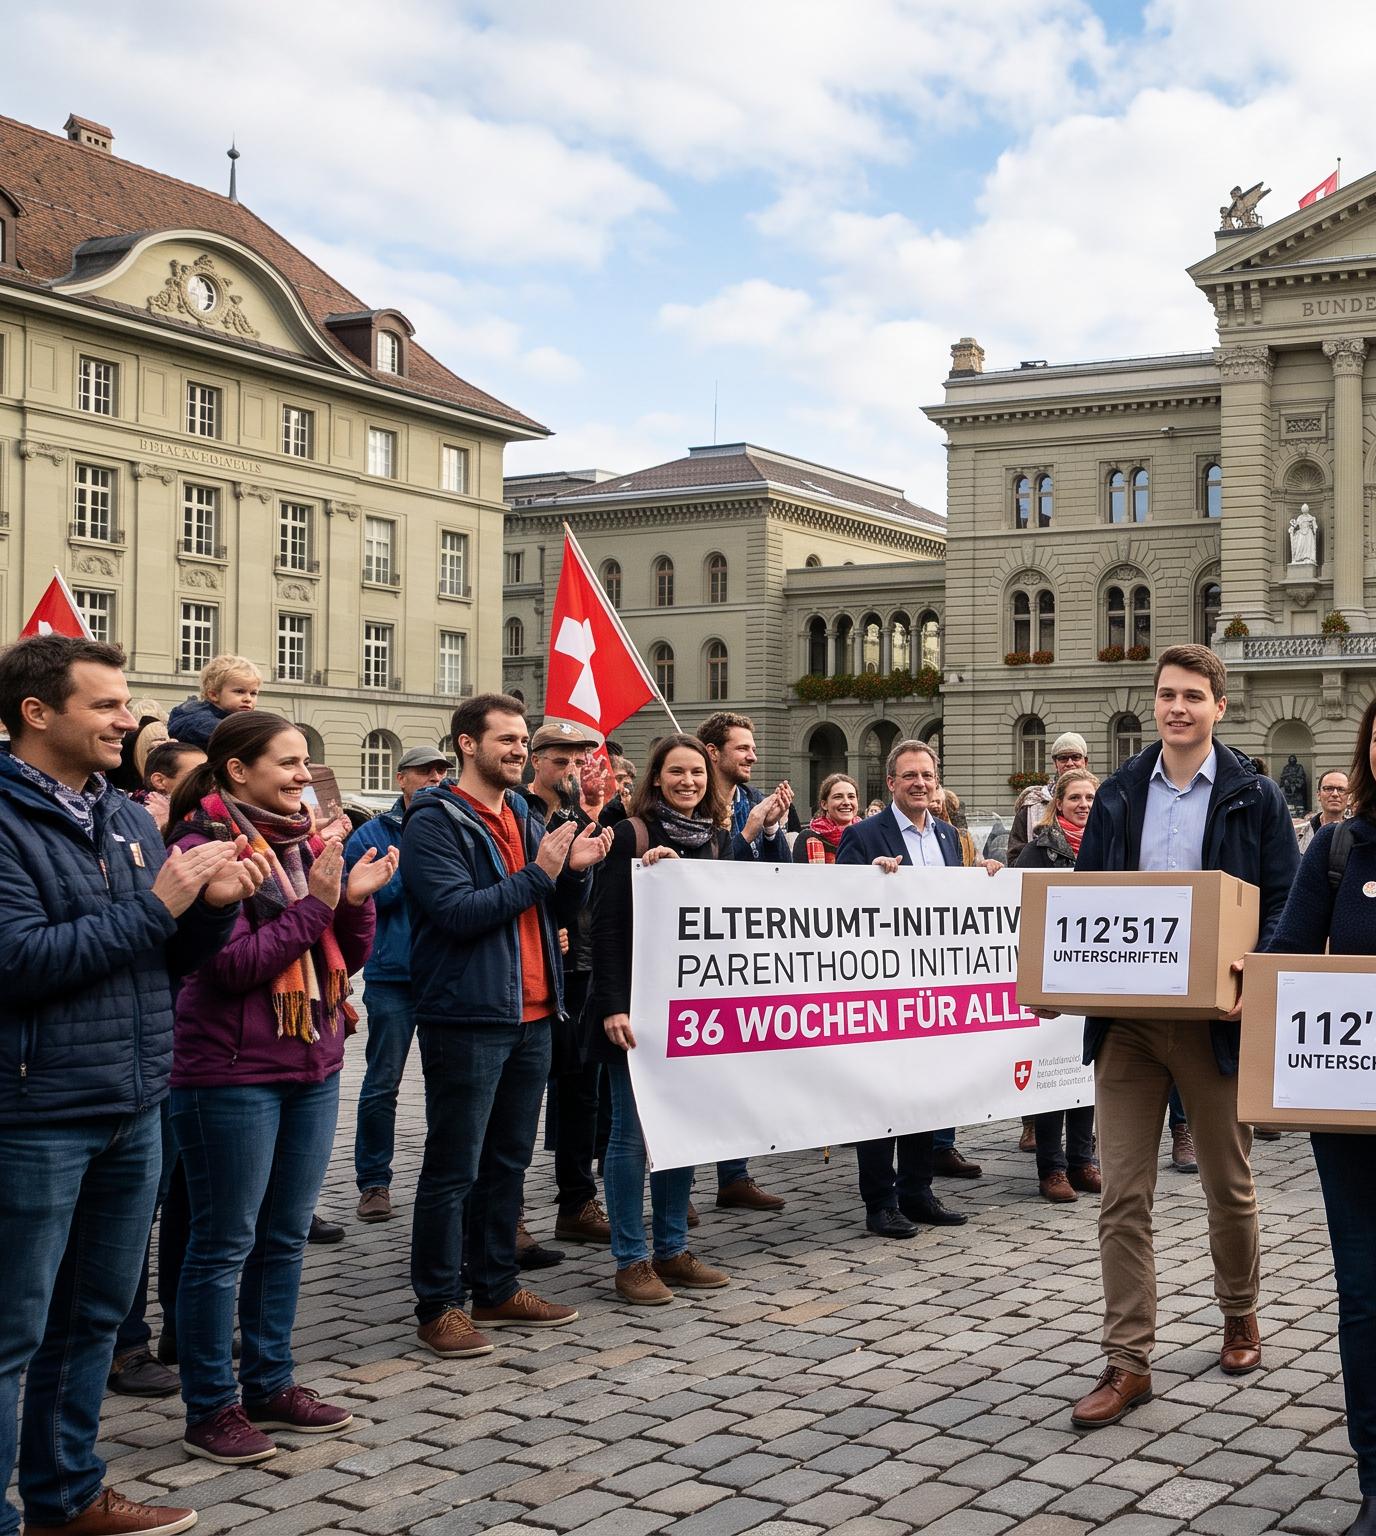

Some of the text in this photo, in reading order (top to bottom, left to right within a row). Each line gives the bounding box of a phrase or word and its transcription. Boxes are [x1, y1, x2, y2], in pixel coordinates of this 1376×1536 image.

[1056, 915, 1179, 945] 112'517
[677, 949, 900, 988] PARENTHOOD
[1053, 950, 1178, 964] UNTERSCHRIFTEN
[675, 1008, 725, 1048] 36
[735, 999, 888, 1043] WOCHEN
[897, 989, 958, 1031] FÜR
